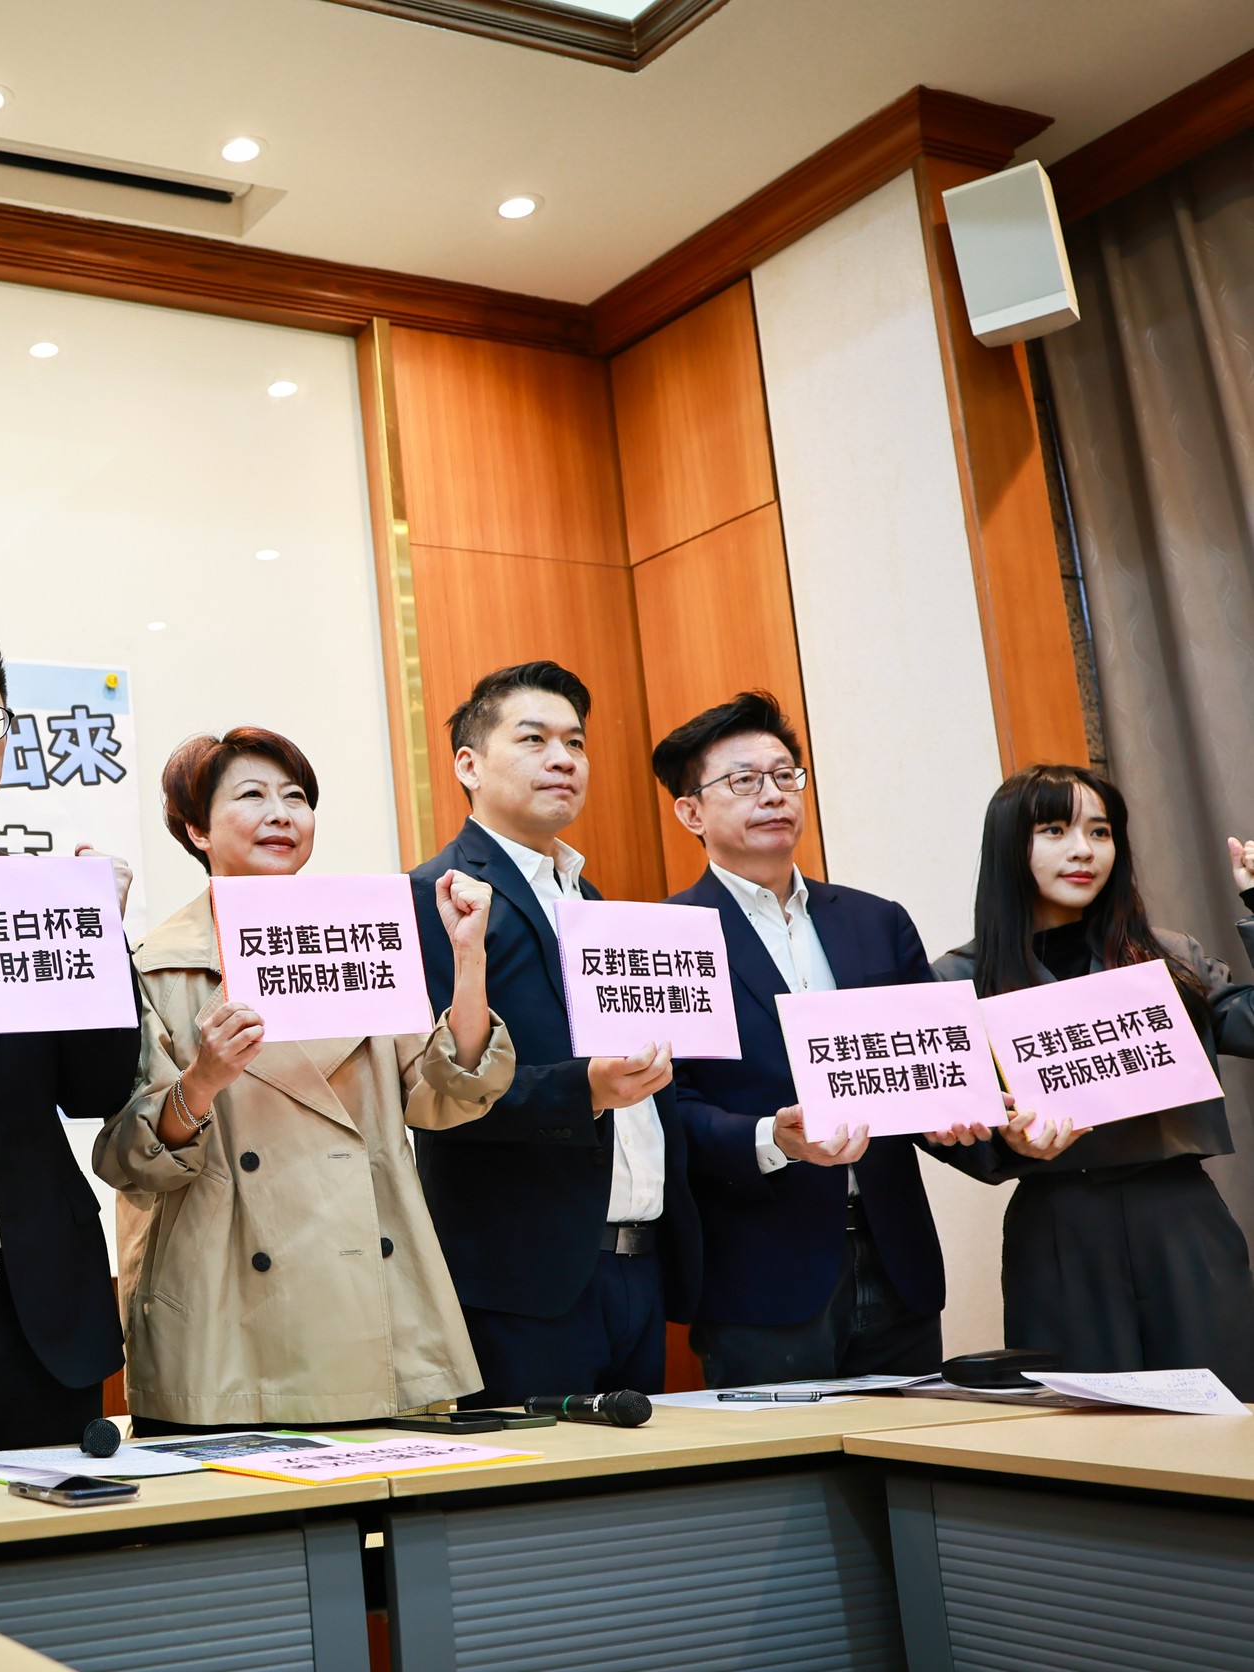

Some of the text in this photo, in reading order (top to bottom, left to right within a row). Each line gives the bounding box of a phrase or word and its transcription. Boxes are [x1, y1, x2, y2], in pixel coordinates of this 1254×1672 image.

[240, 922, 402, 957] 反對藍白杯葛
[257, 961, 395, 996] 院版財劃法
[582, 948, 716, 978] 反對藍白杯葛
[596, 985, 712, 1013] 院版財劃法
[808, 1025, 970, 1064] 反對藍白杯葛
[1012, 1005, 1173, 1063] 反對藍白杯葛
[827, 1061, 967, 1098] 院版財劃法
[1038, 1041, 1176, 1094] 院版財劃法
